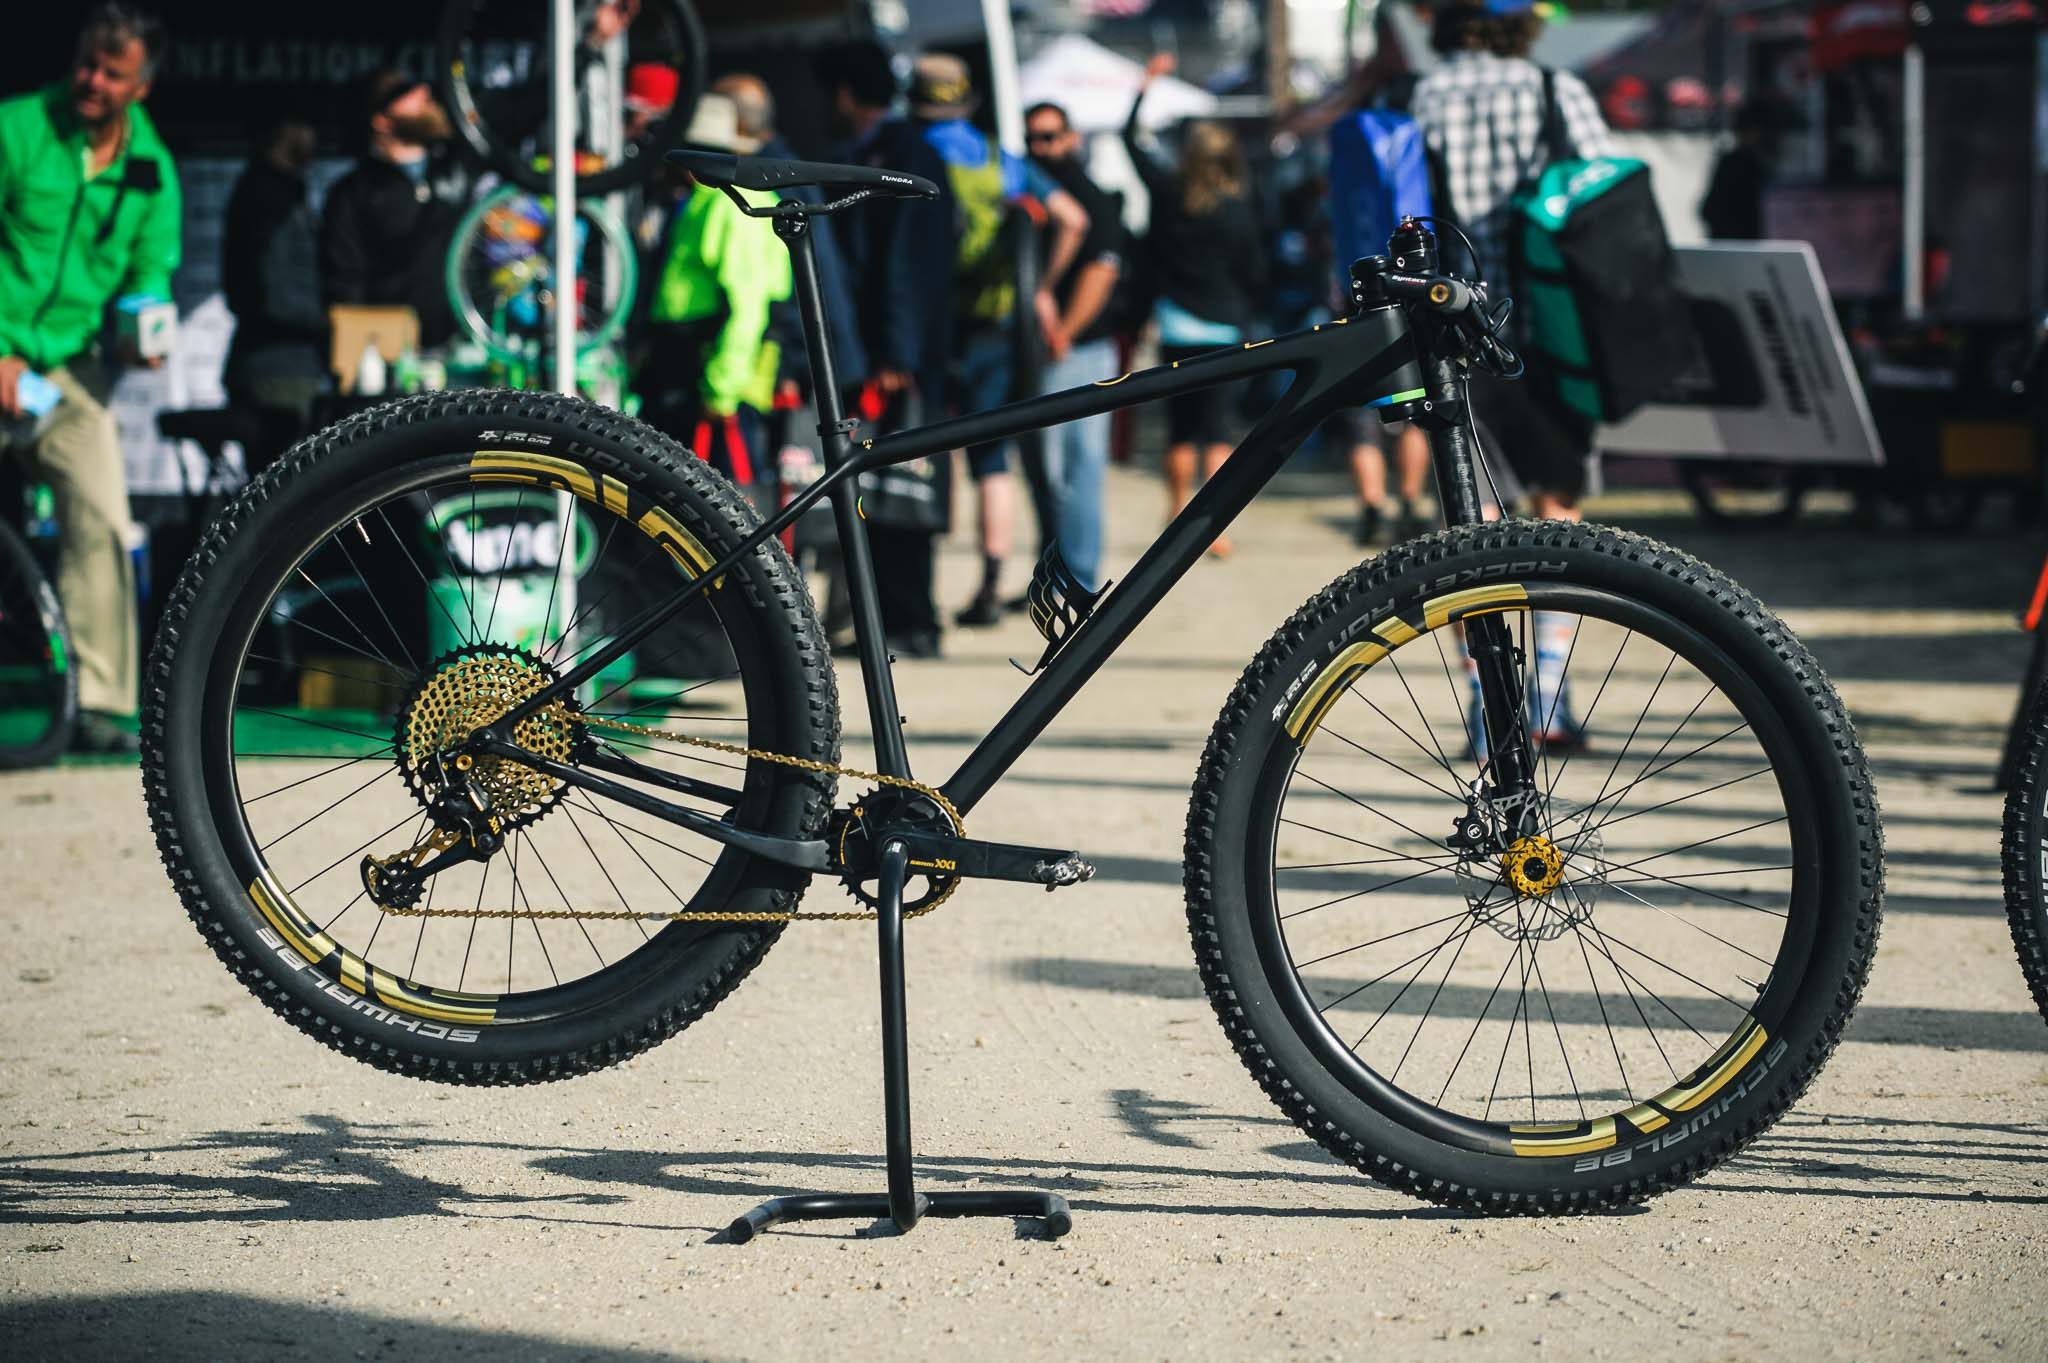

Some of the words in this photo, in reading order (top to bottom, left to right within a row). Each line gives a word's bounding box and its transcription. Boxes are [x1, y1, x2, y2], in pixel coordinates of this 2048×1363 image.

[881, 175, 913, 185] TUNDRA
[568, 440, 648, 482] RON
[1412, 560, 1568, 600] ROCKET
[1327, 598, 1396, 654] RON
[935, 858, 957, 871] XX1
[256, 927, 481, 1043] SCHWALBE
[1573, 1037, 1789, 1173] SCHWALBE
